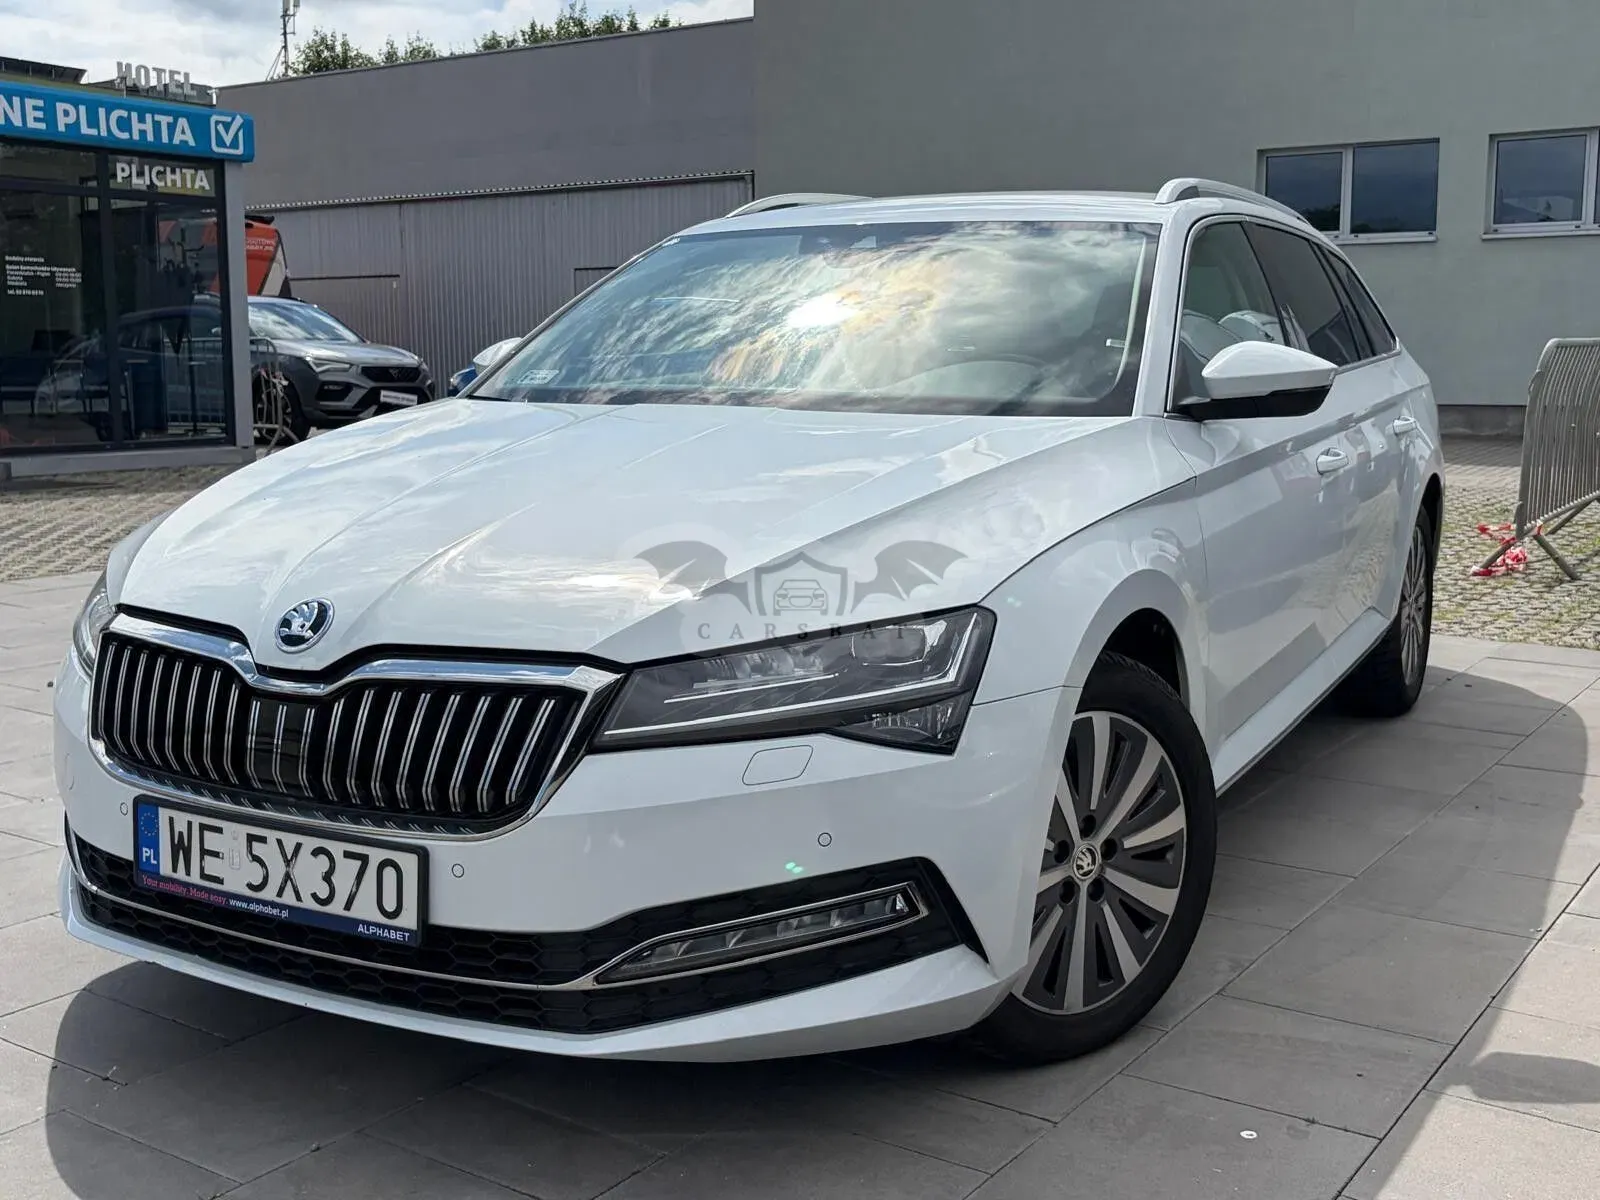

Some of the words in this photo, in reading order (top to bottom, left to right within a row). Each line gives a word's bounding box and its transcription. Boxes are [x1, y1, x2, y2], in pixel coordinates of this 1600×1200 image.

[116, 61, 197, 97] HOTEL
[56, 102, 196, 147] PLICHTA
[116, 161, 211, 191] PLICHTA
[142, 846, 158, 866] PL
[168, 816, 225, 886] WE
[246, 832, 404, 921] 5X370
[142, 874, 158, 888] Your
[159, 881, 189, 895] mobility.
[189, 887, 209, 899] Made
[209, 893, 229, 905] easy.
[229, 897, 289, 919] www.alphabet.pl
[357, 923, 410, 943] ALPHABET
